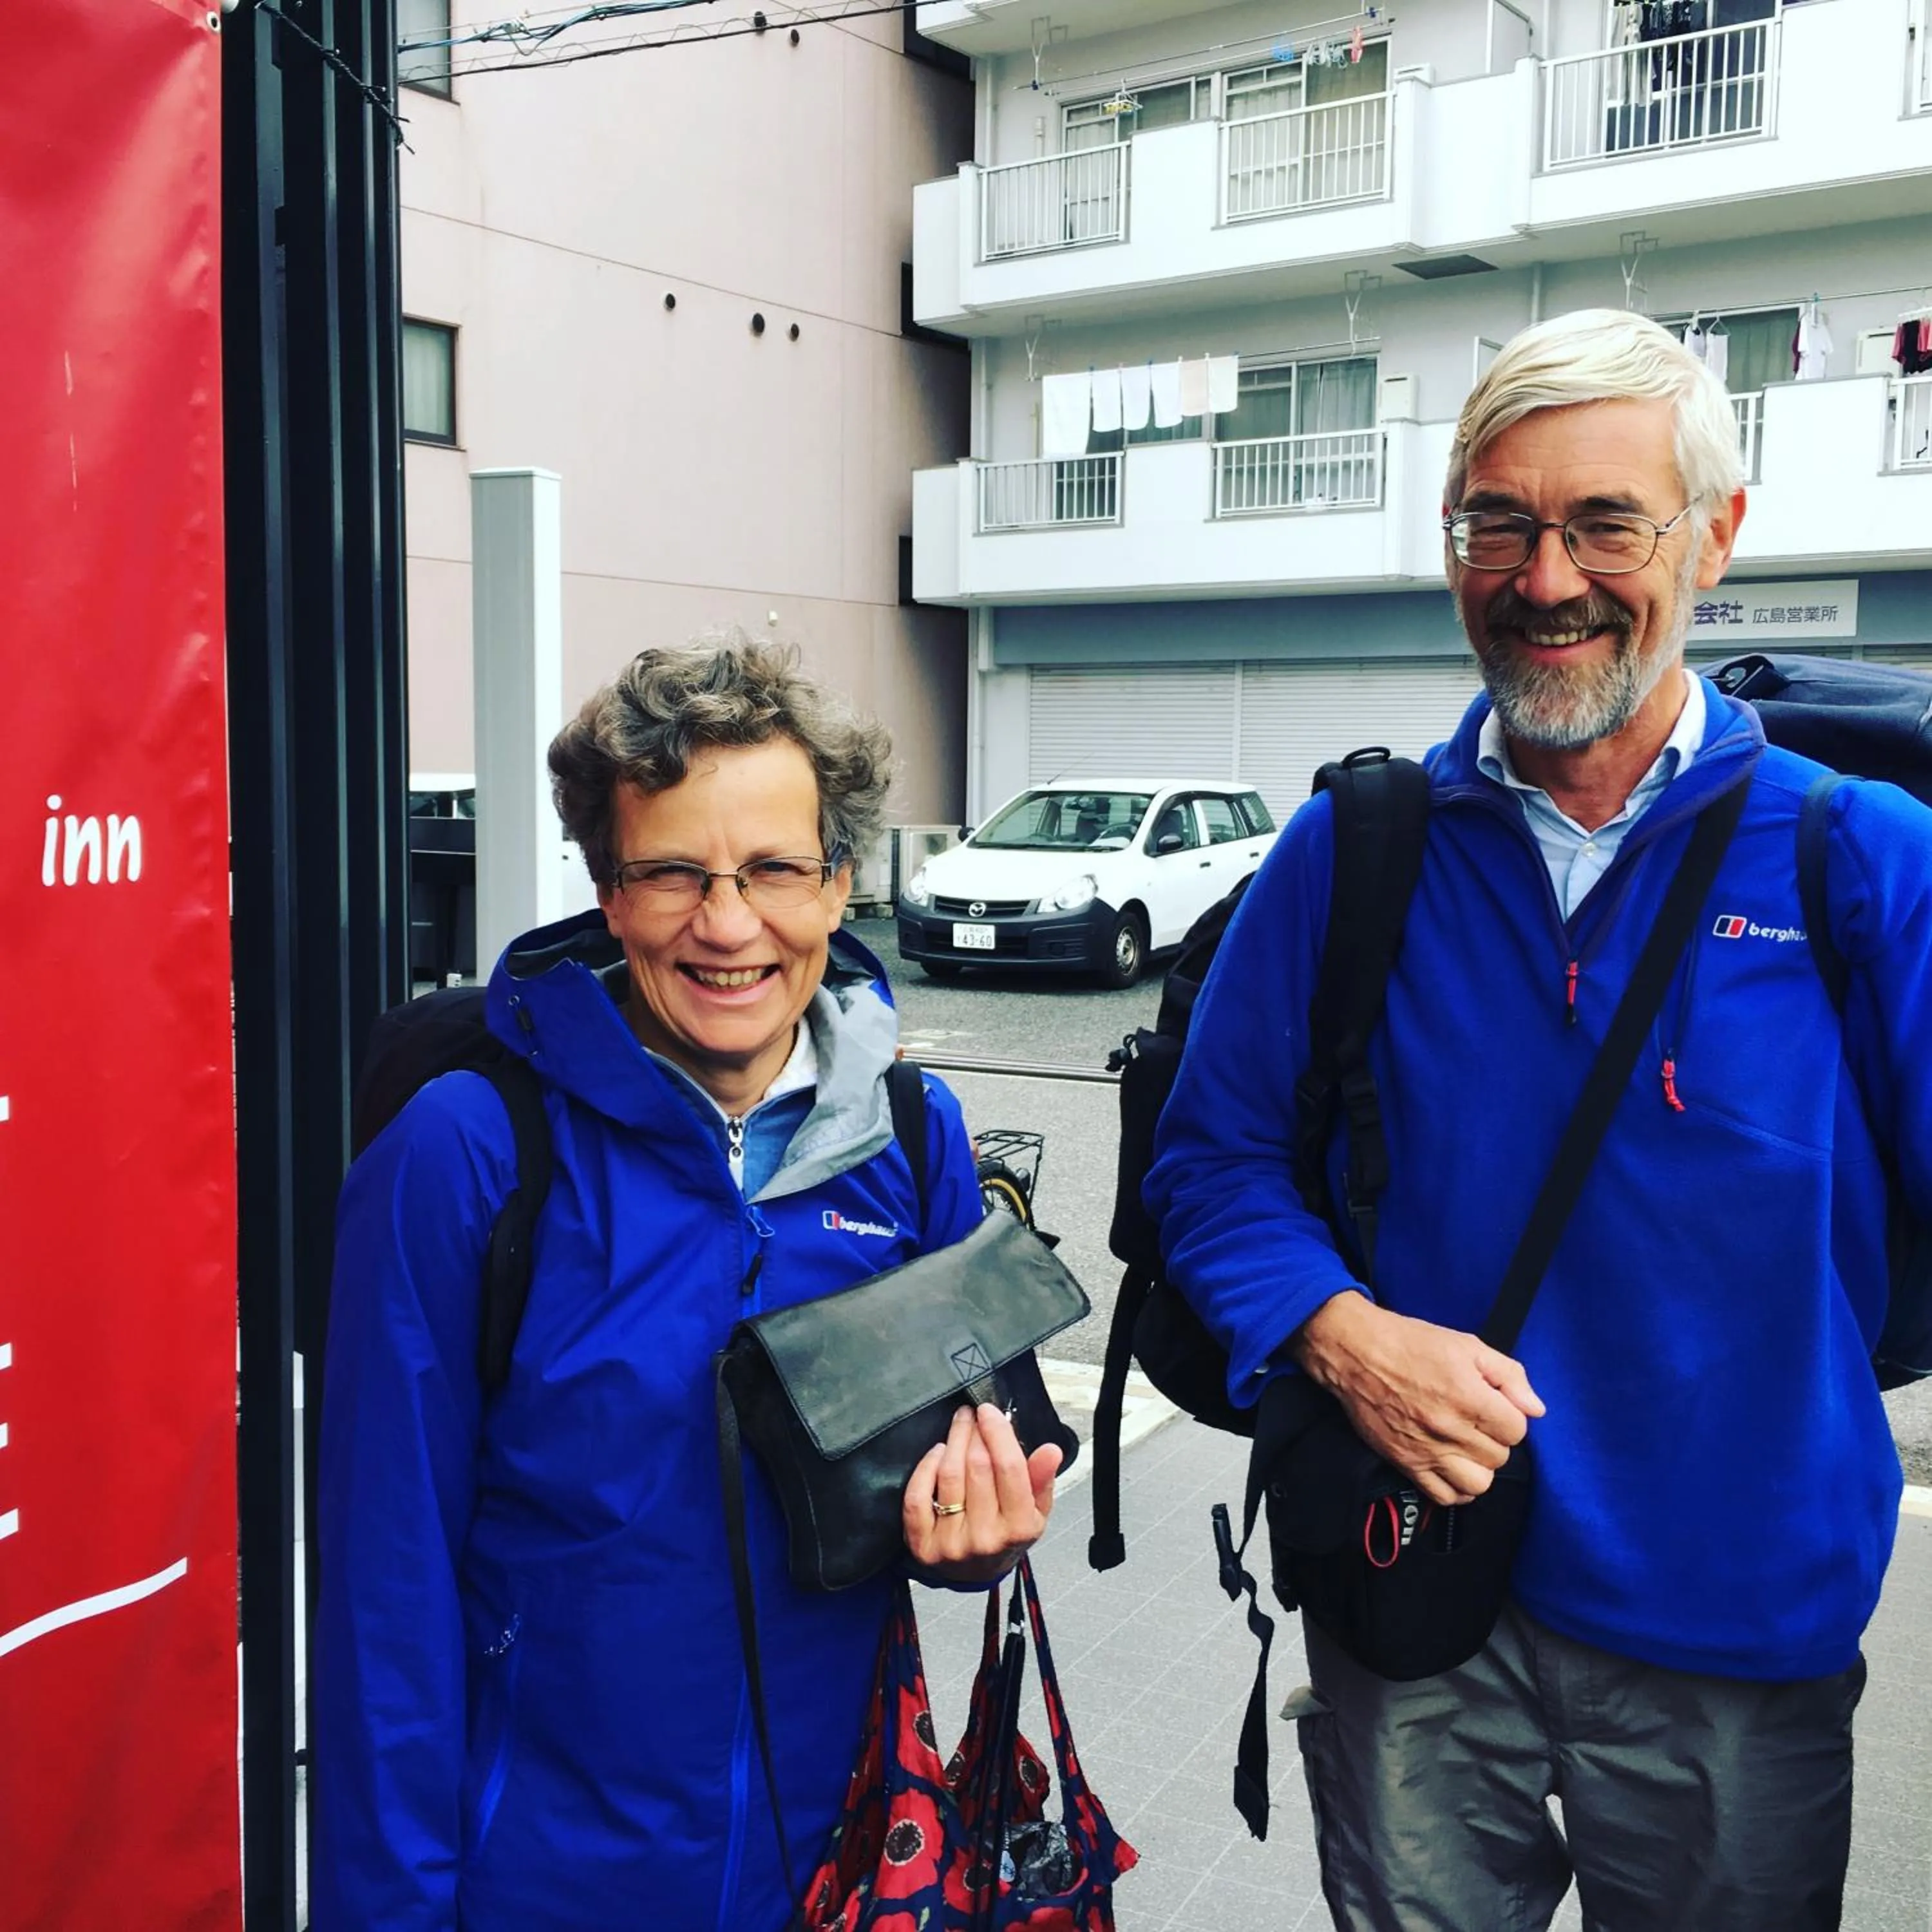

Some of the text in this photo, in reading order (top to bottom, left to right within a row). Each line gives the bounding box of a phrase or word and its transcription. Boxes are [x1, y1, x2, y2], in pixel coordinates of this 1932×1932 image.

[1693, 600, 1838, 625] 会社 広島営業所
[42, 794, 142, 887] inn
